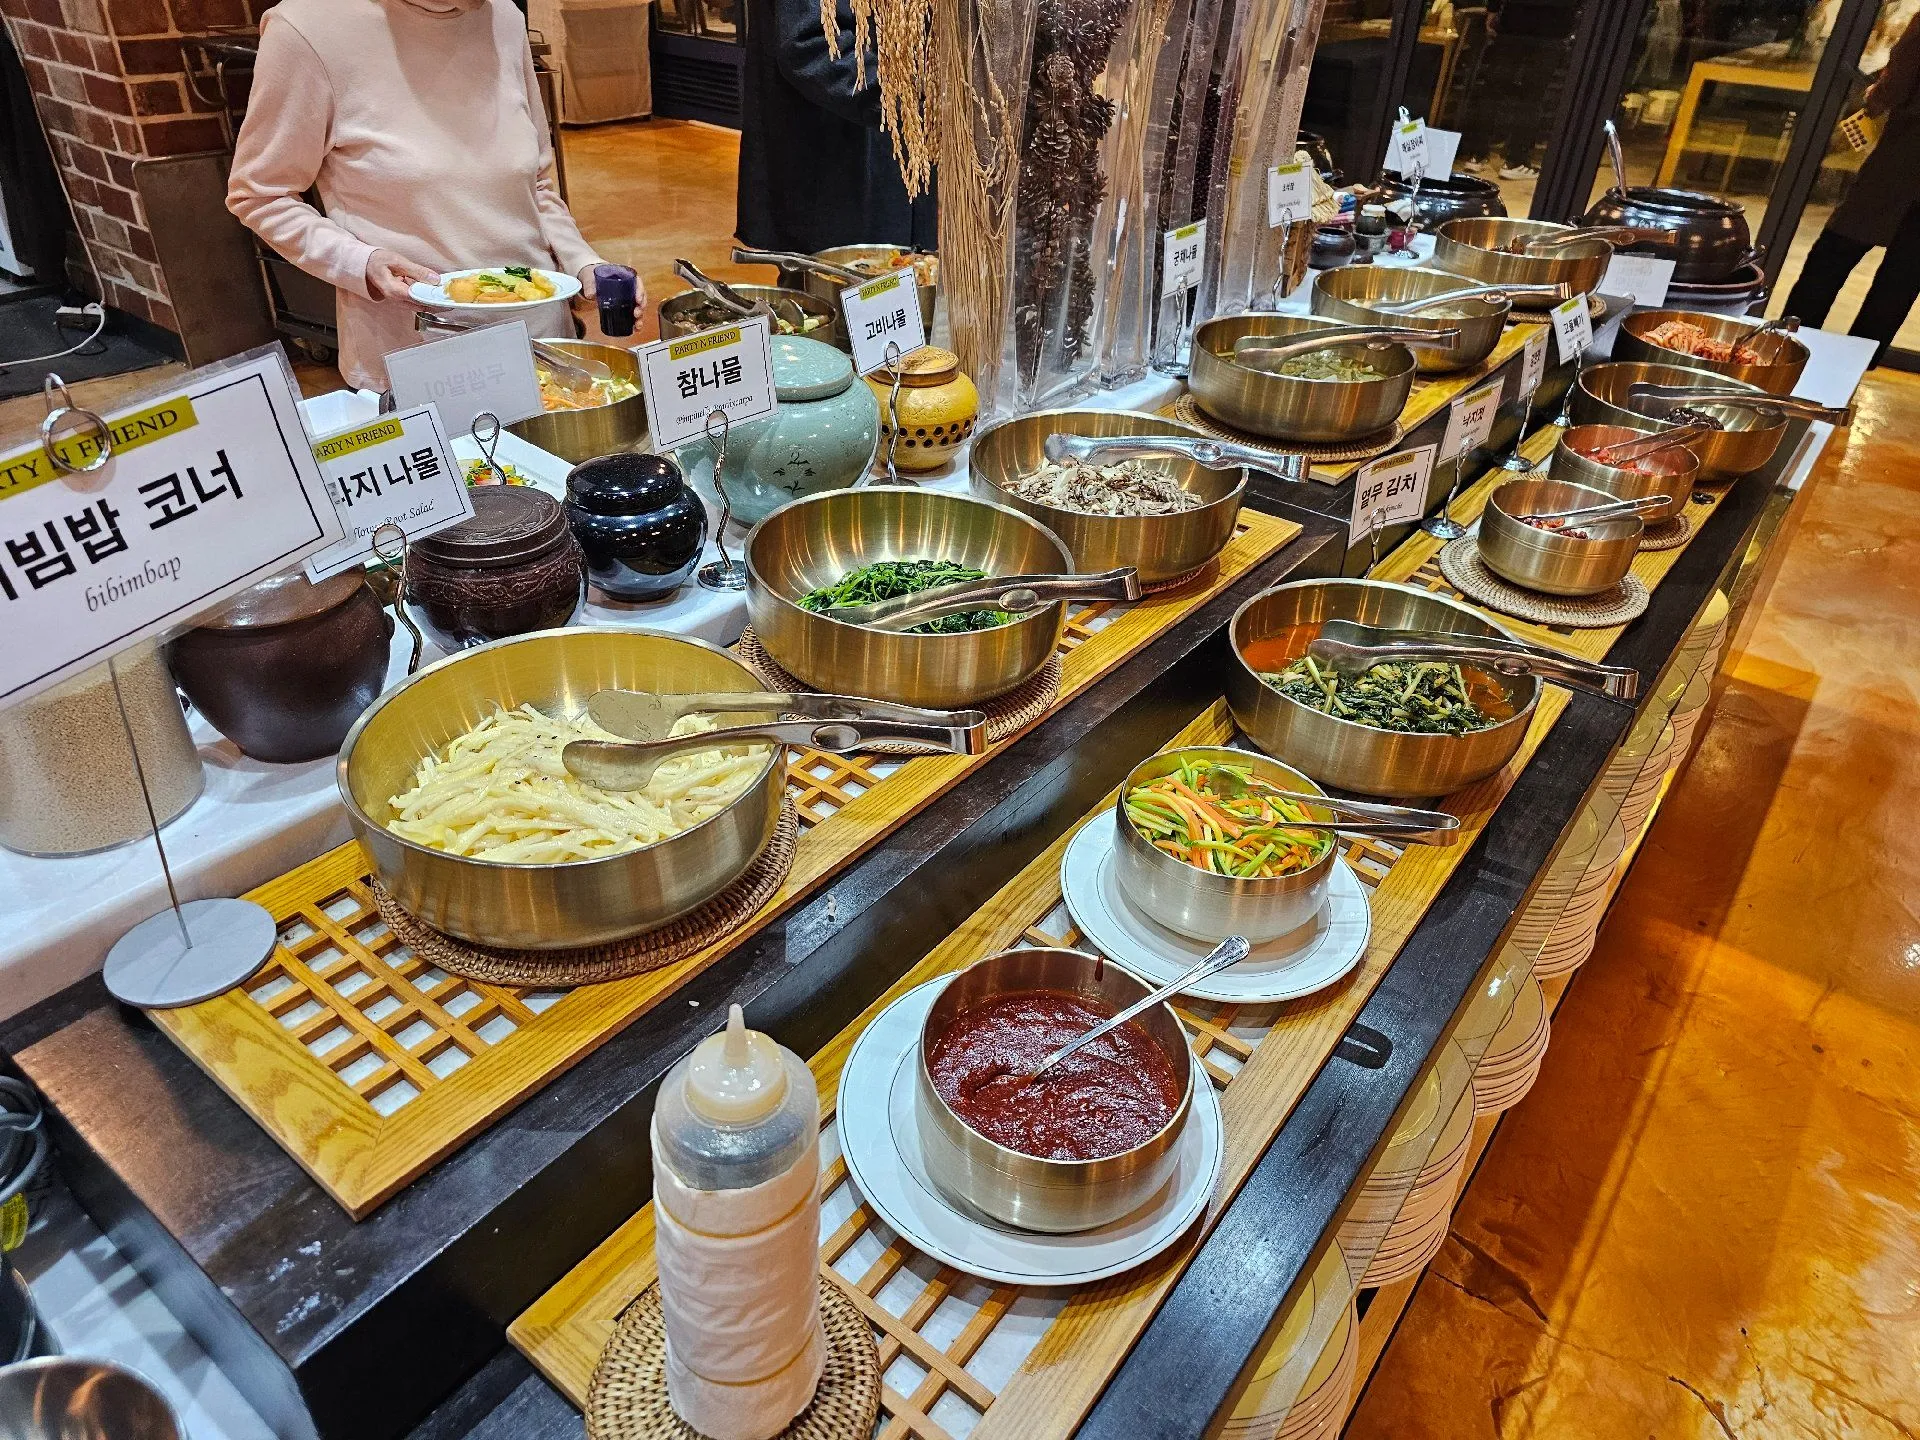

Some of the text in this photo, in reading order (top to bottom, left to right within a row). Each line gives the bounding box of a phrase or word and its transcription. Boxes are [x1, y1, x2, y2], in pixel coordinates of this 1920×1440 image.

[674, 331, 736, 356] PARTY N FRIEND
[865, 308, 907, 341] 고비나물
[676, 355, 742, 399] 참나물
[76, 408, 178, 458] FRIEND
[1462, 405, 1486, 427] 낙지젓
[345, 436, 355, 448] N
[356, 424, 396, 446] FRIEND
[383, 446, 441, 486] 나물
[137, 449, 244, 531] 코너
[409, 498, 435, 519] Salad
[1360, 471, 1418, 510] 열무 김치
[84, 555, 182, 612] bibimbap
